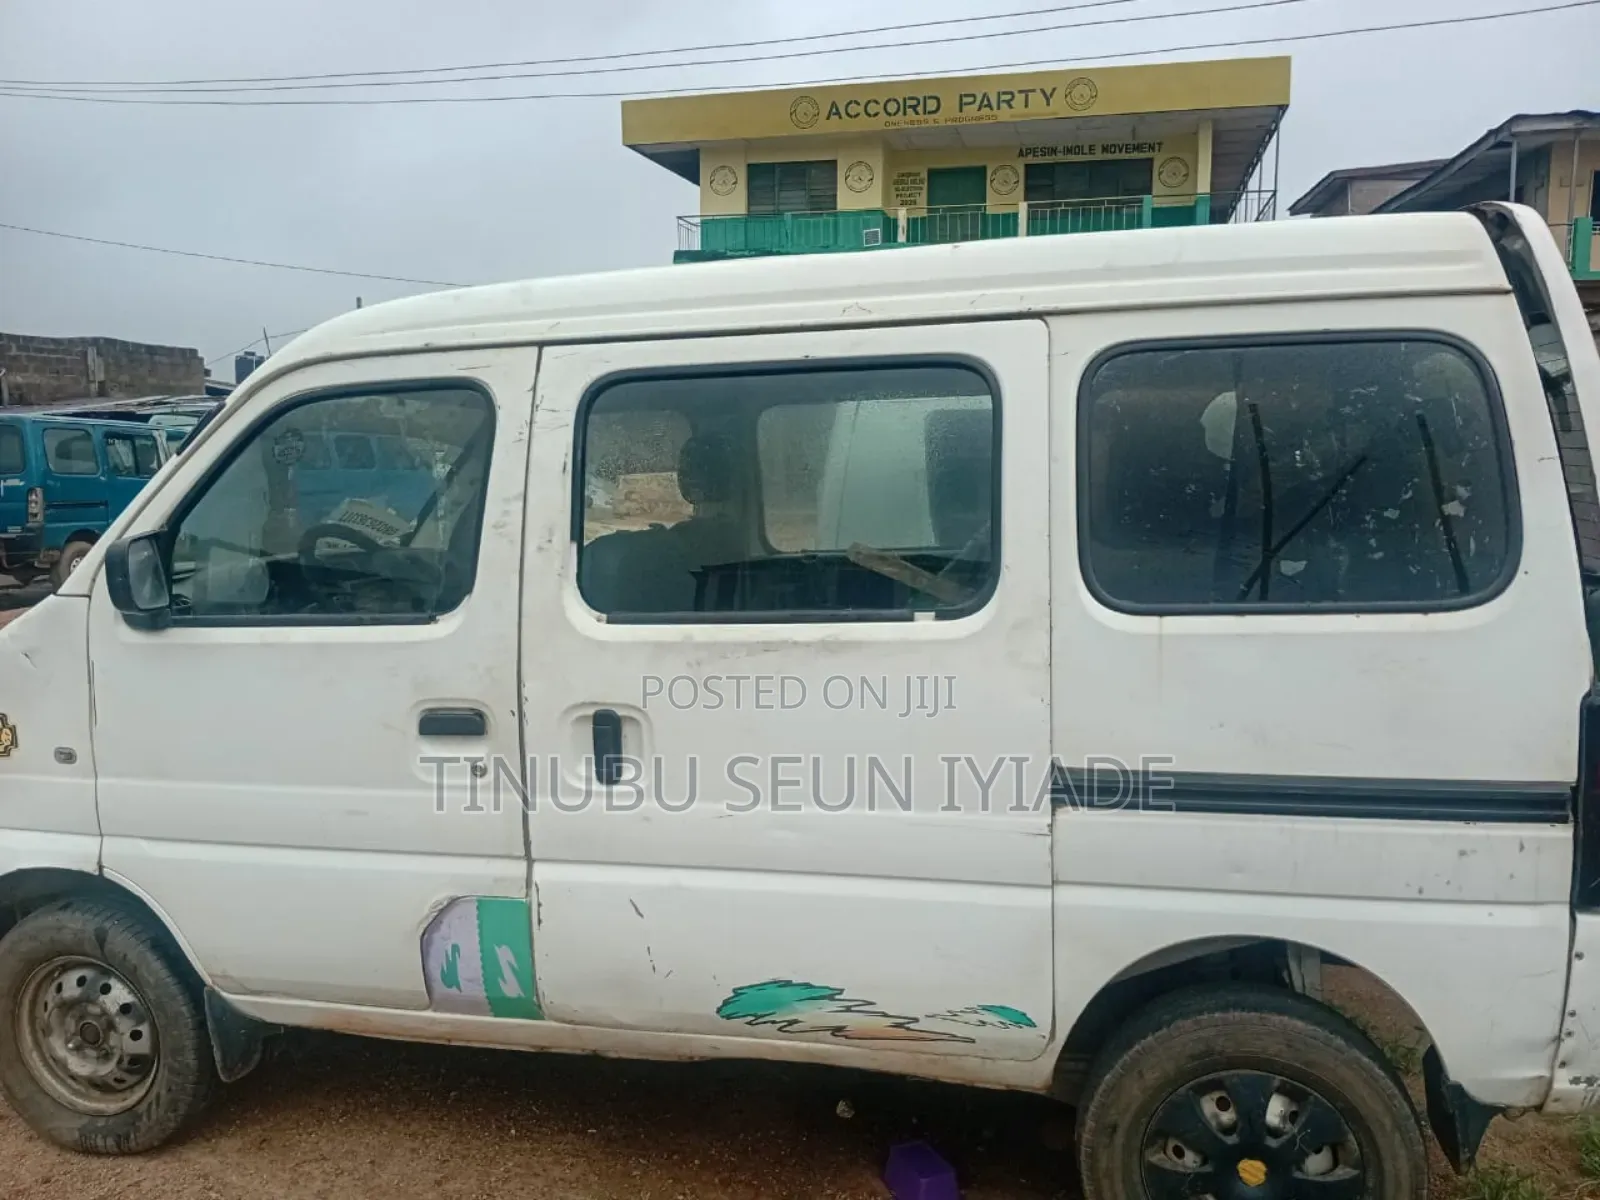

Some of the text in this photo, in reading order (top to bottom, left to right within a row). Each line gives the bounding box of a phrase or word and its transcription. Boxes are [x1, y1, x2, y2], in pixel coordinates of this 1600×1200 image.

[825, 86, 1058, 121] ACCORD PARTY
[1017, 141, 1164, 158] APESIN-IMOLE MOVEMENT
